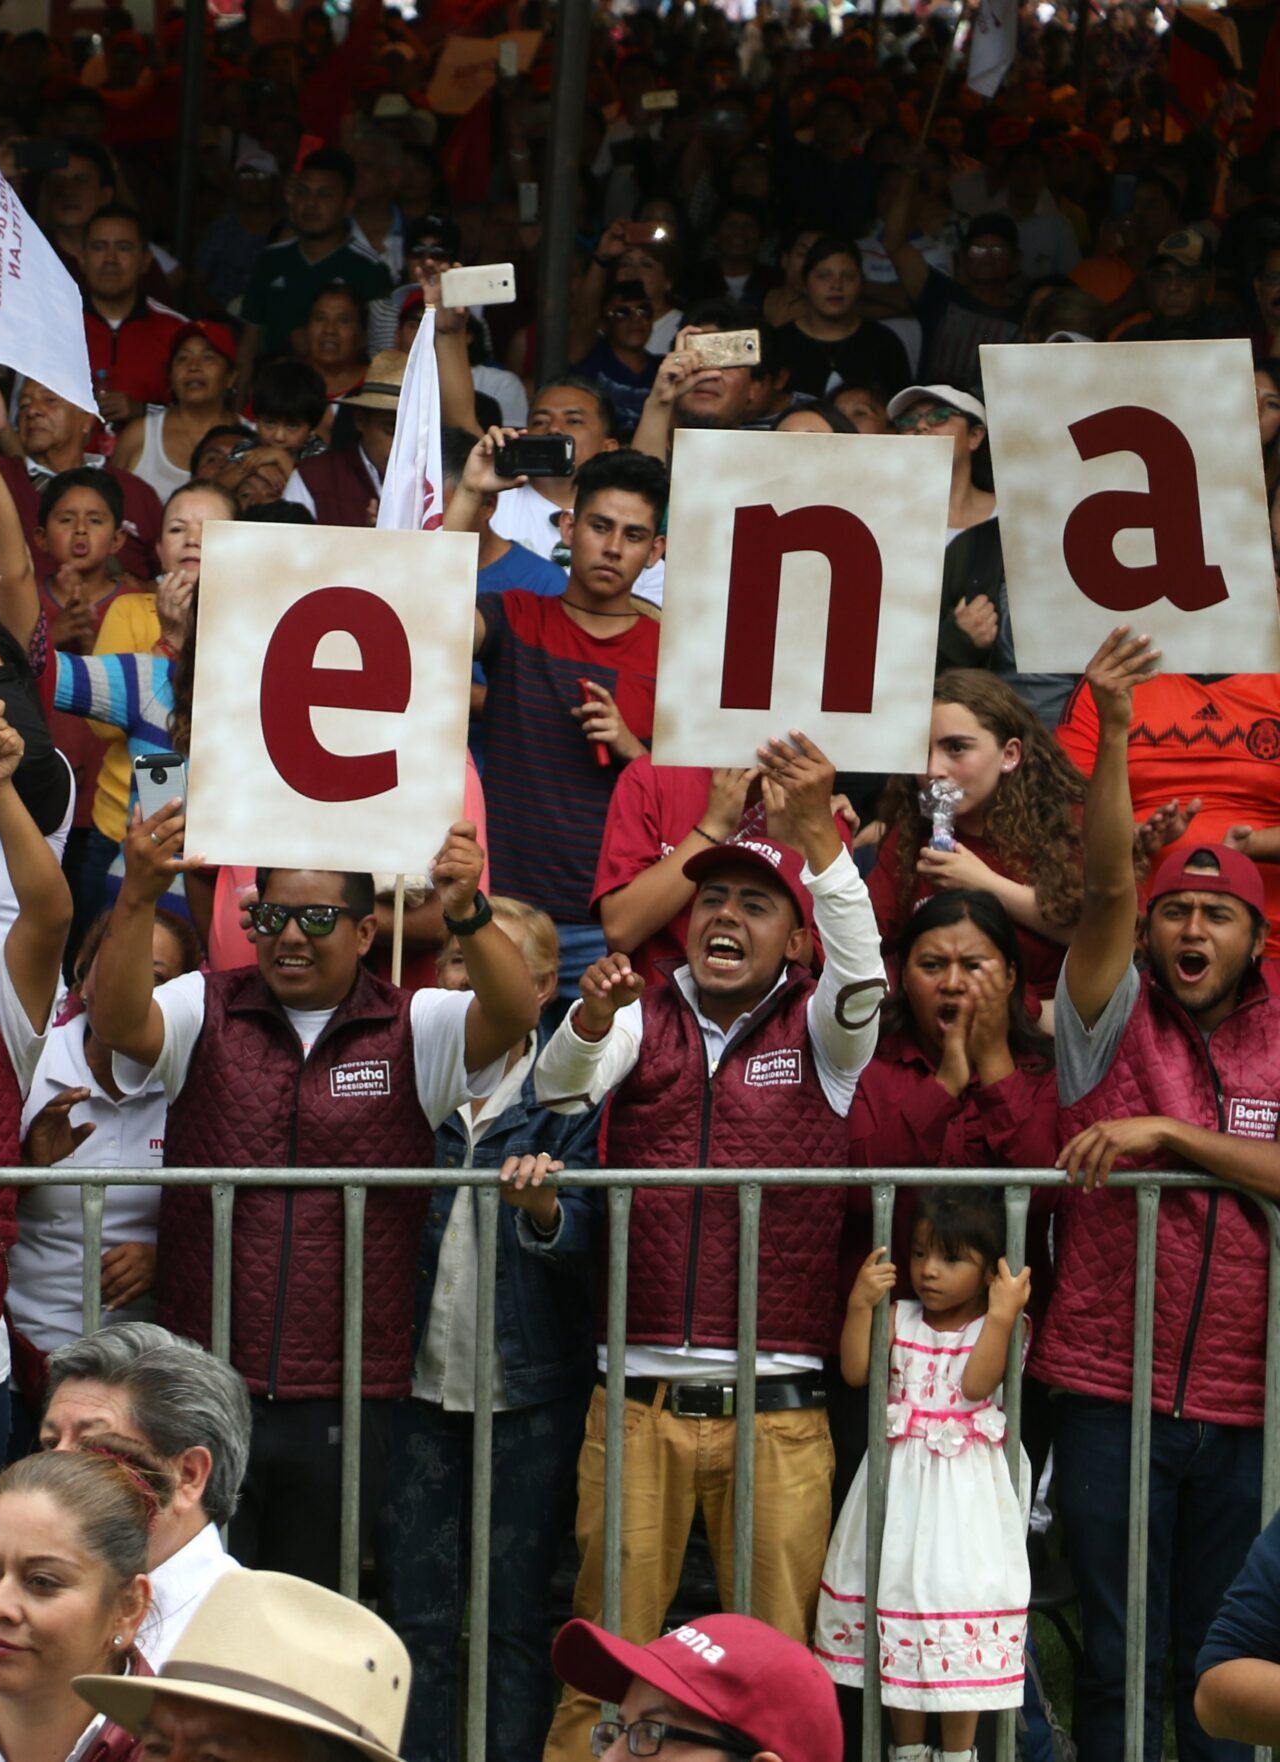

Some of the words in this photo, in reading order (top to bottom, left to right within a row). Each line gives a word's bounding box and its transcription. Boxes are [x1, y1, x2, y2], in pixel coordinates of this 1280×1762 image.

[1063, 405, 1229, 612] a
[720, 503, 883, 714] n
[260, 586, 412, 802] e
[737, 841, 782, 865] rena
[336, 1067, 384, 1083] Bertha
[751, 1070, 795, 1081] PRESIDENTA
[752, 1056, 796, 1073] Bertha
[337, 1081, 384, 1091] PRESIDENTA
[663, 1625, 726, 1664] rena
